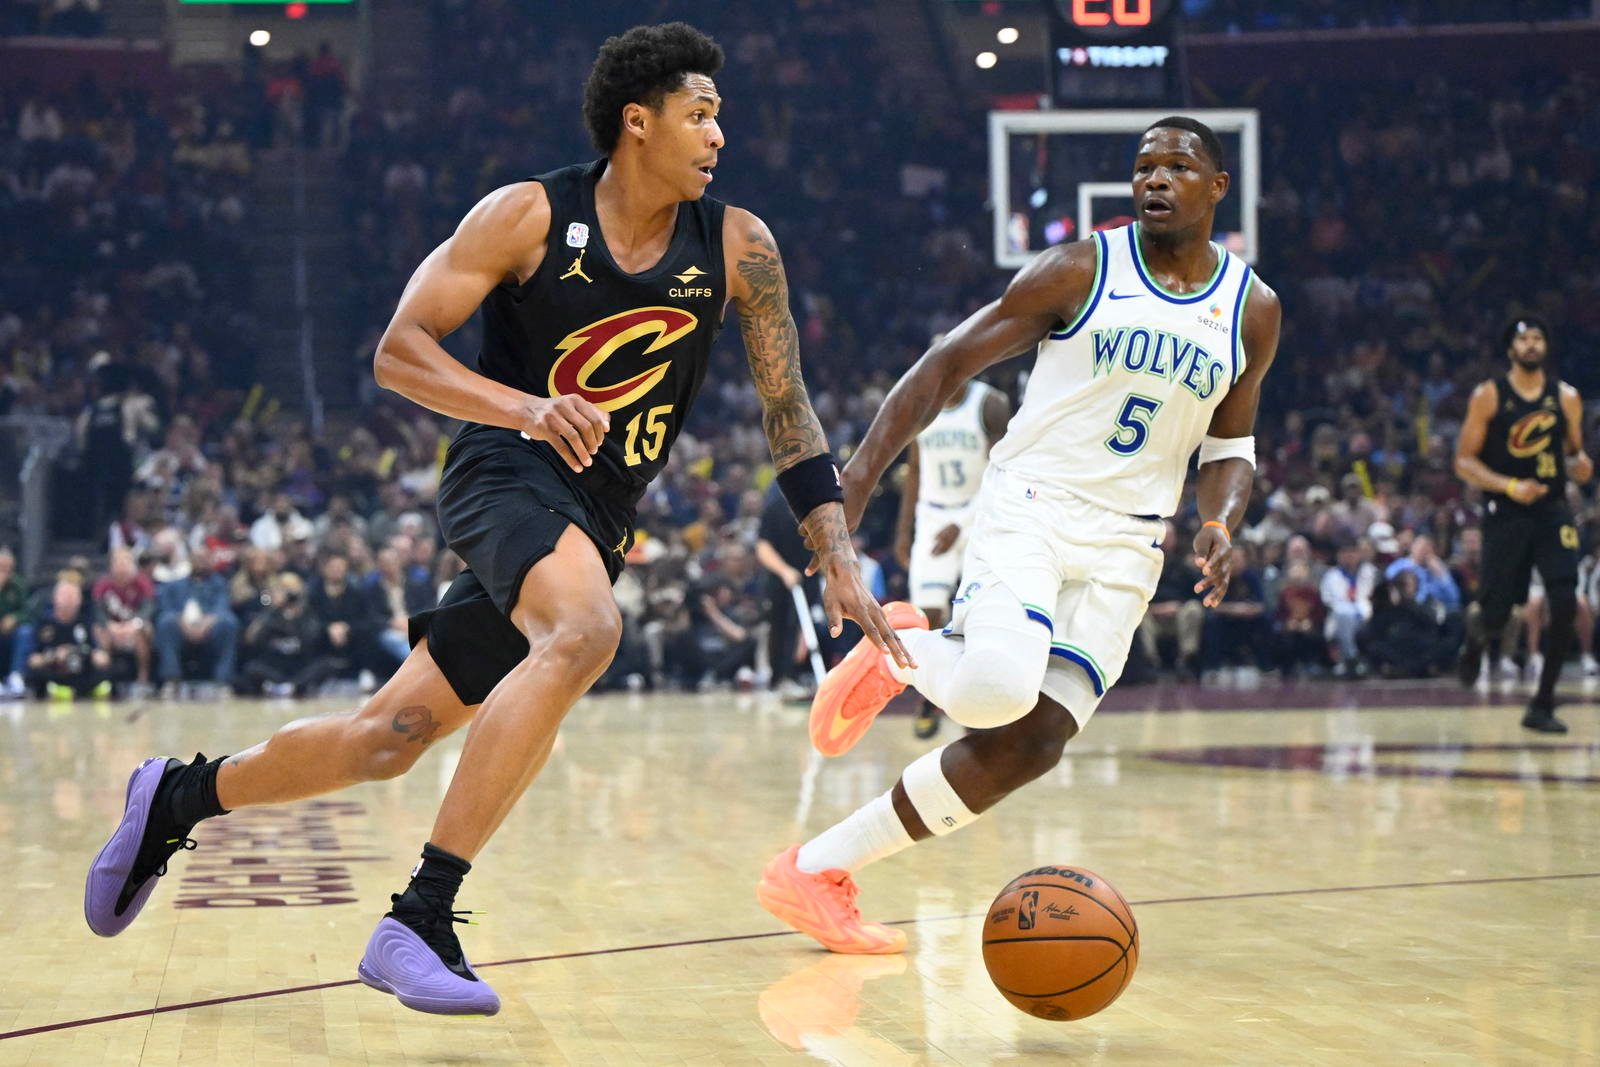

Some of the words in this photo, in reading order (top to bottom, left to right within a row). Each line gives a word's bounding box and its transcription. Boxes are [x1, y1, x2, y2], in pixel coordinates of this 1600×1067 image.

[669, 287, 712, 298] CLIFFS
[1197, 315, 1229, 335] sezzle
[1091, 326, 1227, 401] WOLVES
[624, 404, 674, 467] 15
[1104, 392, 1163, 457] 5
[938, 459, 967, 488] 13
